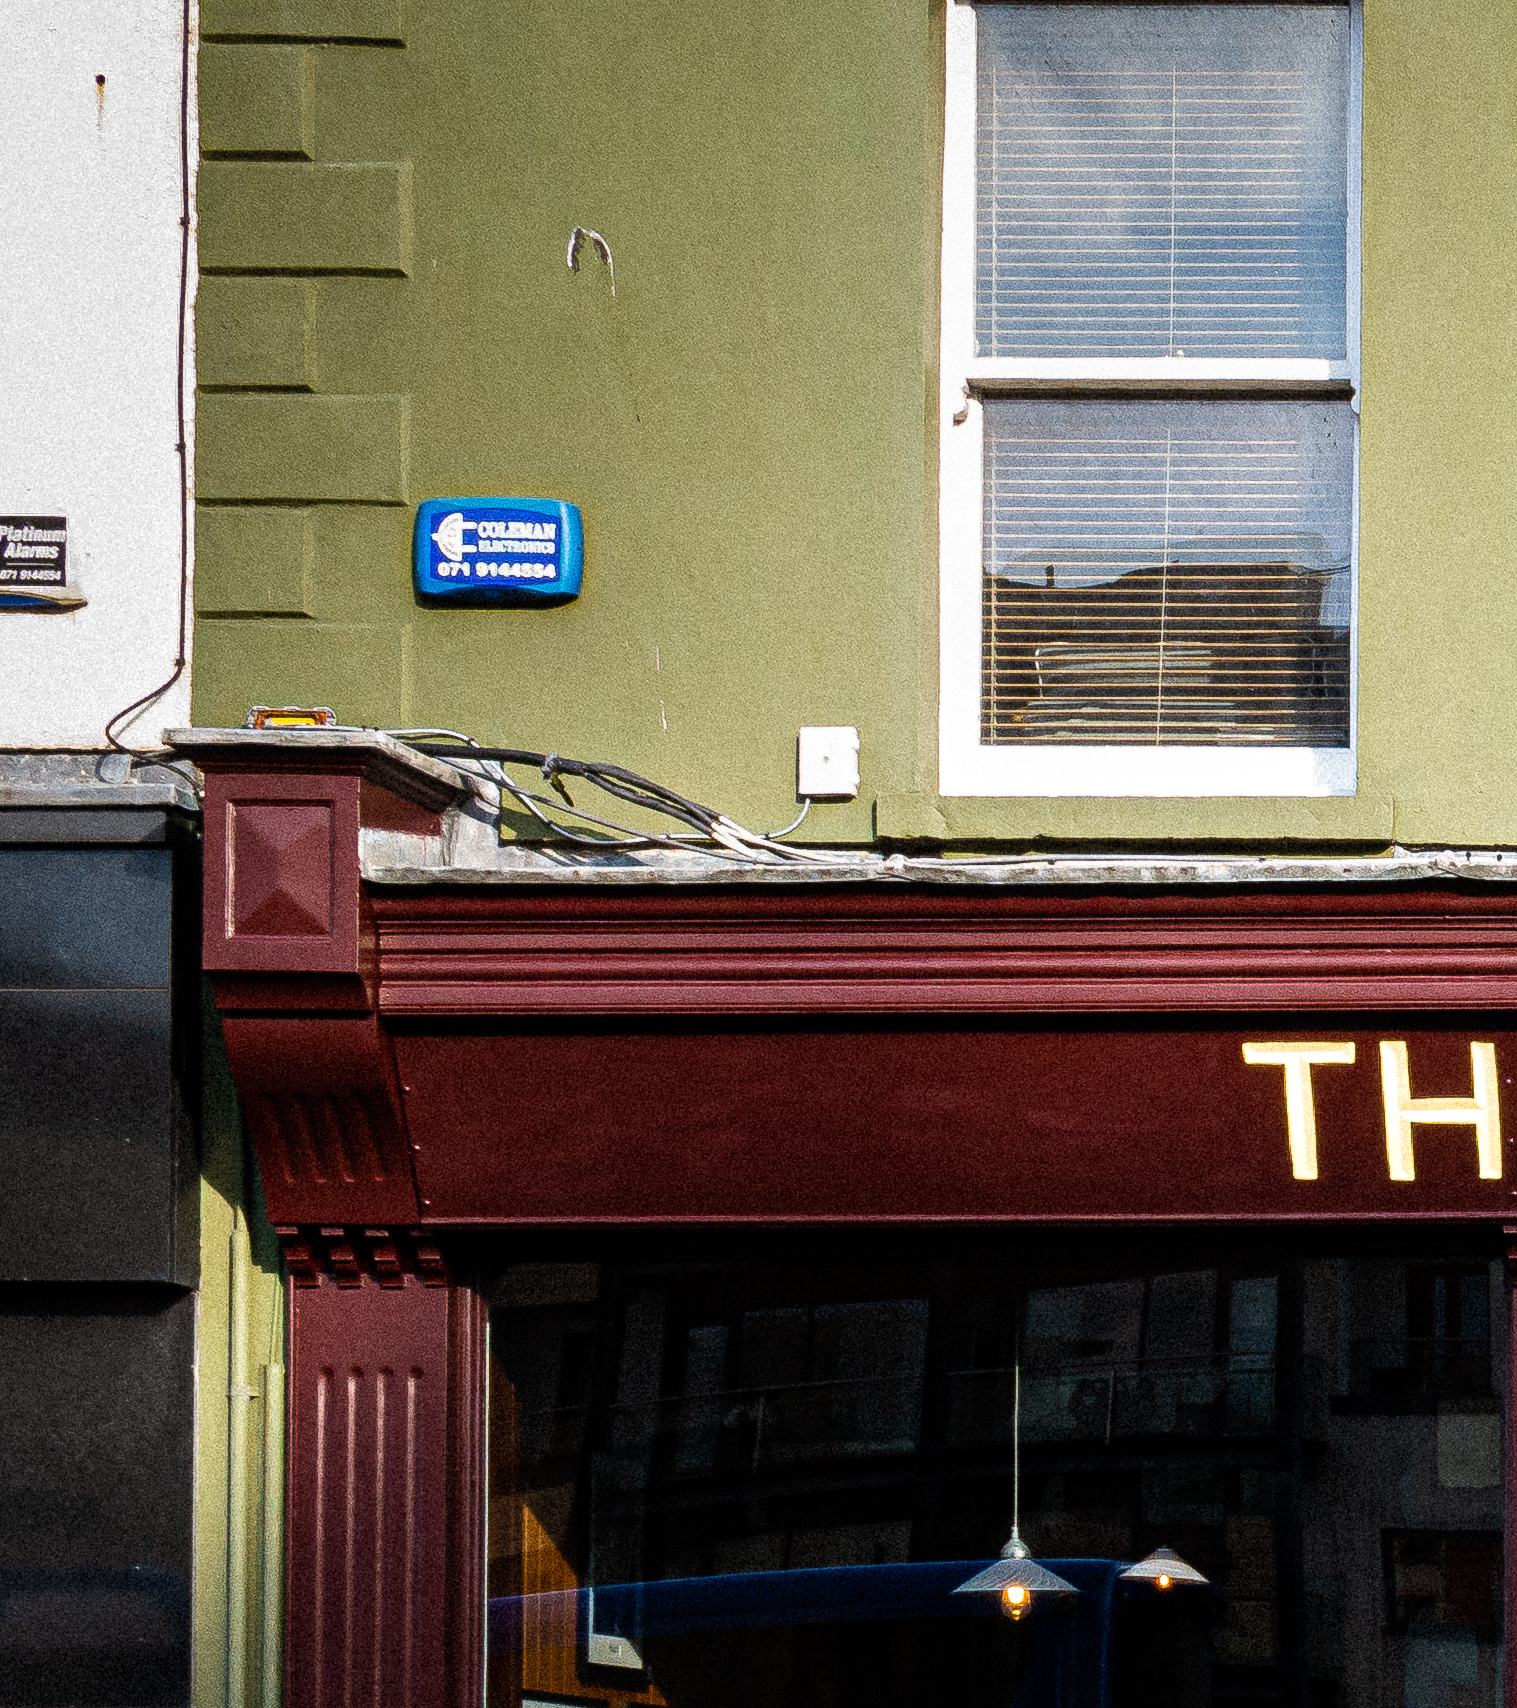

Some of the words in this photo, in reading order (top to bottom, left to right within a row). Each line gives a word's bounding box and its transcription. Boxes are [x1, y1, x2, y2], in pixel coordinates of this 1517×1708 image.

[0, 525, 67, 542] Platinum
[477, 521, 556, 540] COLEMAN
[3, 542, 60, 558] Alarms
[477, 539, 555, 554] ELECTRONICS
[436, 562, 471, 577] 071
